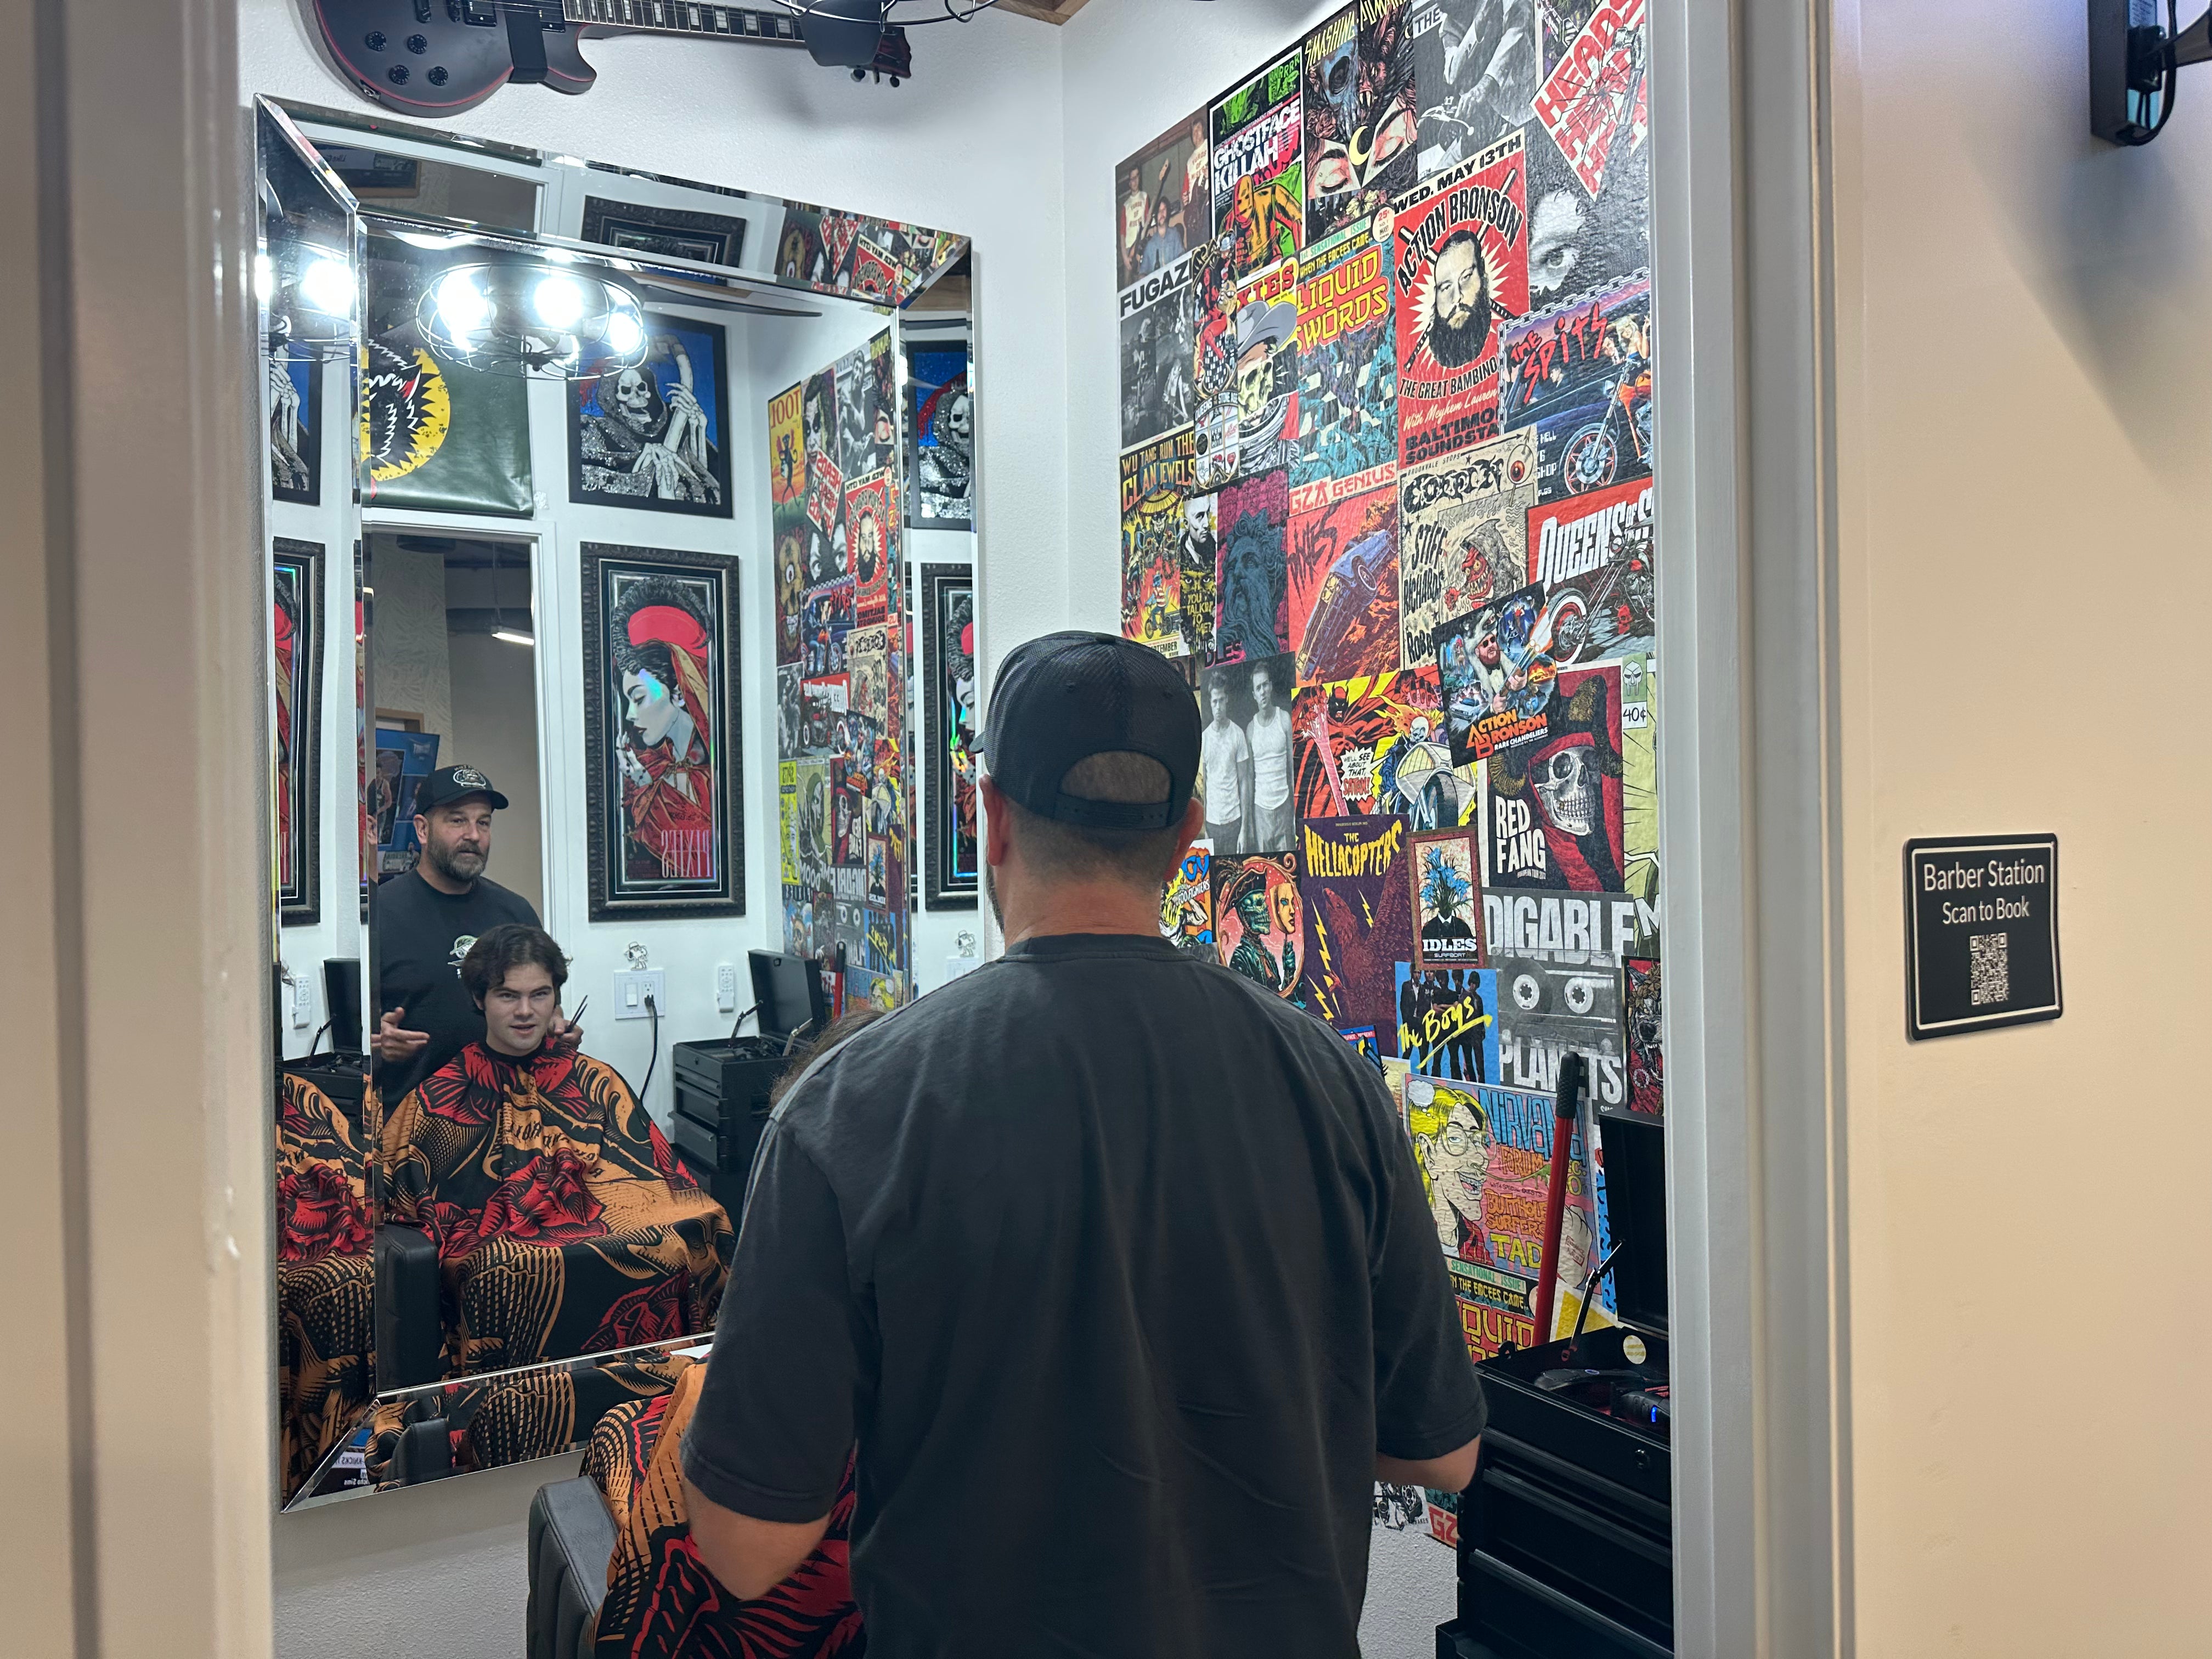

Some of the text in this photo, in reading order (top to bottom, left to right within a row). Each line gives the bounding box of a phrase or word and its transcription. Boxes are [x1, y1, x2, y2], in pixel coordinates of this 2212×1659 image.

[1415, 9, 1440, 33] THE
[1305, 11, 1356, 75] SMASHING
[1214, 98, 1300, 170] GHOSTFACE
[1215, 135, 1278, 196] KILLAH
[1393, 136, 1521, 213] WED. MAY 13TH
[1311, 232, 1346, 257] SENSATIONAL
[1351, 217, 1369, 235] ISSUE!
[1396, 187, 1523, 297] ACTION BRONSON
[1300, 262, 1315, 278] WHEN
[1316, 255, 1327, 268] THE
[1328, 245, 1351, 263] EMCEES
[1120, 258, 1192, 318] FUGAZI
[1296, 250, 1378, 317] LIQUID
[1297, 284, 1388, 352] SWORDS
[1400, 356, 1498, 399] THE GREAT BAMBINO
[1403, 388, 1498, 431] With Meyhem Lauren
[1406, 404, 1499, 450] BALTIMO
[1122, 431, 1194, 476] WU TANG RUN THE
[1406, 423, 1499, 465] SOUNDSTA
[1123, 459, 1194, 512] CLAN JEWELS
[1289, 464, 1395, 515] GZA GENIUS
[1536, 501, 1627, 592] QUEENS
[1188, 594, 1202, 603] YOU
[1193, 614, 1203, 624] TO
[1205, 640, 1246, 669] DLES
[1466, 709, 1517, 749] ACTION
[1474, 713, 1548, 759] BRONSON
[1494, 727, 1548, 751] RARE CHANDELIERS
[1358, 752, 1371, 761] SEE
[1344, 833, 1359, 843] THE
[1496, 795, 1531, 840] RED
[1304, 819, 1403, 878] HELLACOPTERS
[1497, 829, 1547, 873] FANG
[1178, 879, 1210, 906] FOO FIGHTERS
[1923, 859, 2045, 891] Barber Station
[1942, 896, 2030, 924] Scan to Book
[1422, 938, 1477, 952] IDLES
[1422, 996, 1475, 1043] Boys
[1499, 1036, 1622, 1104] PLANTS
[1501, 1146, 1544, 1177] FORUM
[1490, 1232, 1543, 1269] TAD
[1452, 1260, 1496, 1284] SENSATIONAL
[1501, 1276, 1526, 1292] ISSUE!
[1459, 1278, 1471, 1293] THE
[1474, 1282, 1501, 1302] EMCEES
[1459, 1302, 1534, 1351] QUID
[1429, 1506, 1458, 1544] GZ
